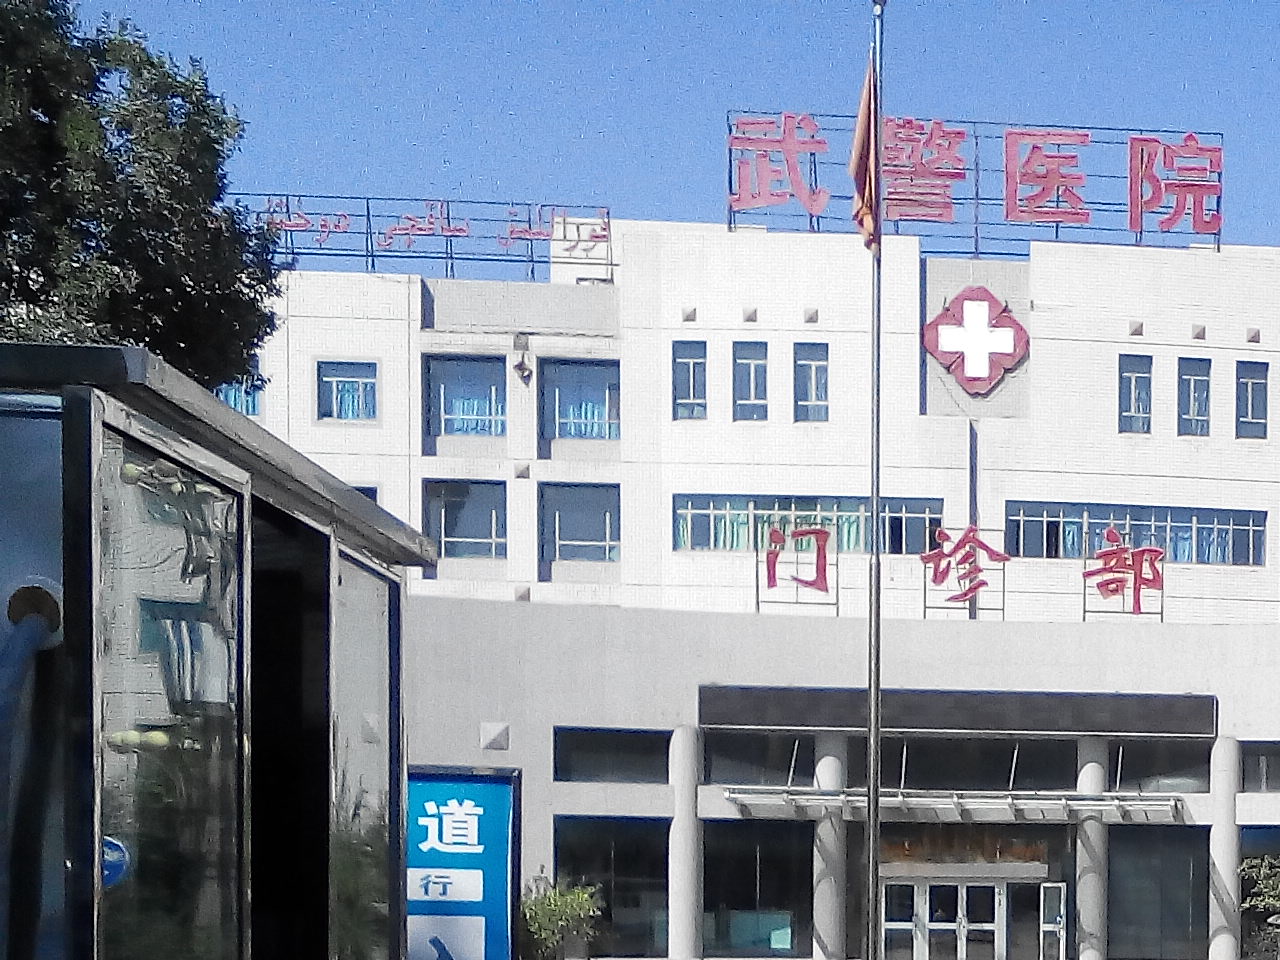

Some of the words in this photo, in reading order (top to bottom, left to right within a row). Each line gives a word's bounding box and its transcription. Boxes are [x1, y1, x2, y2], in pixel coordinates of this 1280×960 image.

[729, 113, 1224, 234] 武警医院
[766, 525, 1165, 615] 门诊部
[417, 798, 484, 854] 道
[419, 873, 454, 898] 行
